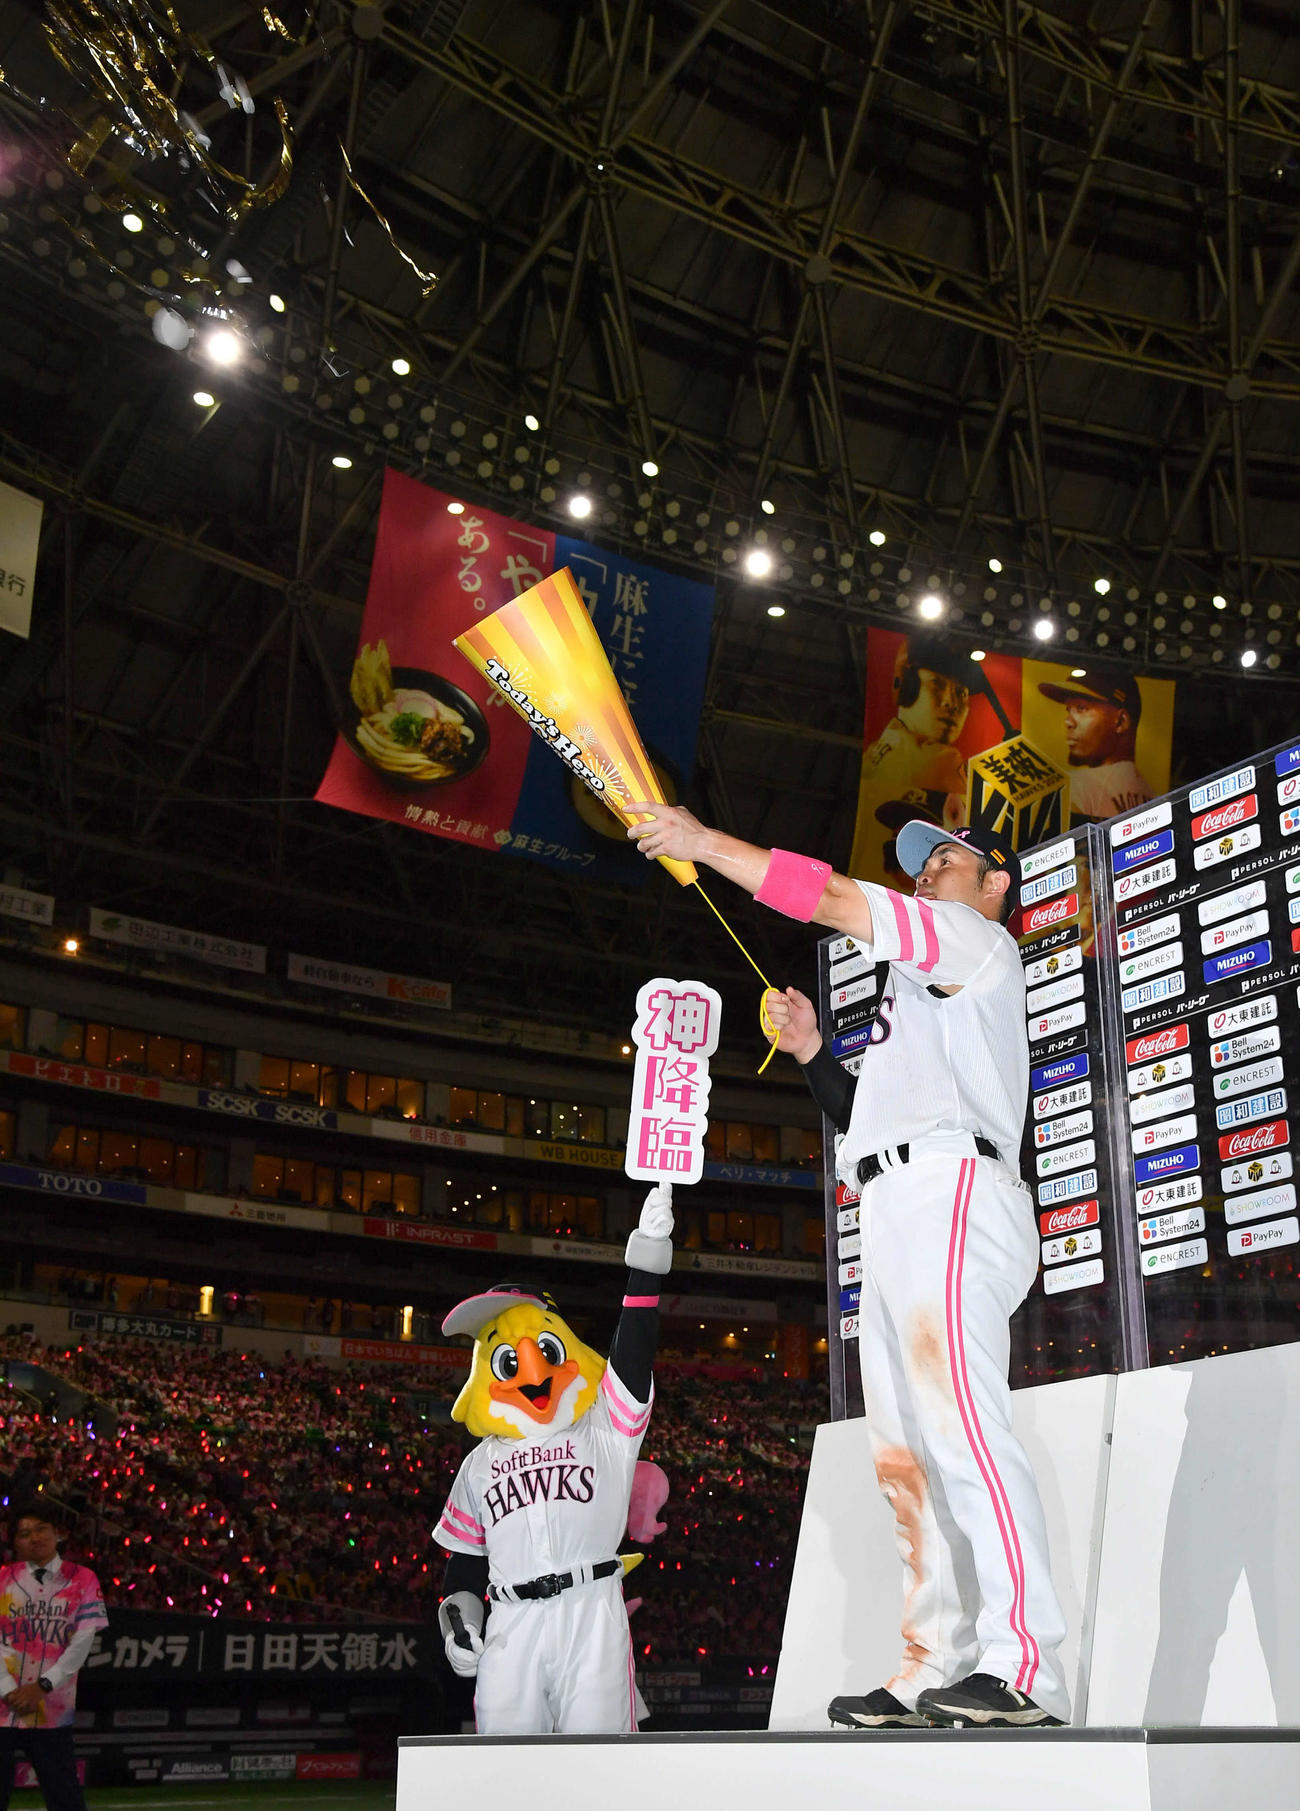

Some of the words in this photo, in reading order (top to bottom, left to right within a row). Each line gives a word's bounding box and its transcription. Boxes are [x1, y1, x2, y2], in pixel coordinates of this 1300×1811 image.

[457, 516, 490, 611] ある。
[485, 659, 561, 738] Today's
[551, 734, 605, 791] Hero
[1132, 814, 1160, 832] PayPay
[511, 832, 595, 867] 麻生グループ
[1125, 840, 1160, 862] MIZUHO
[1240, 855, 1275, 875] PERSOL
[1132, 866, 1172, 889] 大東建託
[1133, 900, 1165, 916] PERSOL
[1136, 925, 1152, 938] Bell
[1137, 926, 1176, 947] System24
[1225, 923, 1255, 940] PayPay
[1216, 950, 1256, 972] MIZUHO
[1250, 970, 1286, 988] PERSOL
[1141, 1009, 1173, 1025] PERSOL
[1228, 1001, 1272, 1026] 大東建託
[841, 1032, 868, 1049] MIZUHO
[1231, 1036, 1248, 1049] Bell
[1232, 1038, 1275, 1059] System24
[637, 989, 710, 1172] 神降臨
[1043, 1062, 1076, 1081] MIZUHO
[207, 1092, 260, 1117] SCSK
[1050, 1087, 1087, 1109] 大東建託
[1218, 1091, 1283, 1126] 昭和建設
[274, 1104, 328, 1128] SCSK
[1052, 1119, 1066, 1131] Bell
[409, 1126, 467, 1147] 信用金庫
[1053, 1121, 1089, 1140] System24
[1155, 1126, 1183, 1140] PayPay
[540, 1144, 565, 1160] WB
[569, 1148, 619, 1167] HOUSE
[1147, 1154, 1184, 1172] MIZUHO
[38, 1172, 102, 1196] TOTO
[1155, 1182, 1197, 1205] 大東建託
[1159, 1215, 1174, 1227] Bell
[1159, 1219, 1200, 1238] System24
[406, 1227, 474, 1244] INFRAST
[1252, 1228, 1284, 1243] PayPay
[490, 1439, 576, 1479] SoftBank
[484, 1464, 595, 1528] HAWKS
[223, 1631, 417, 1673] 日田天領水
